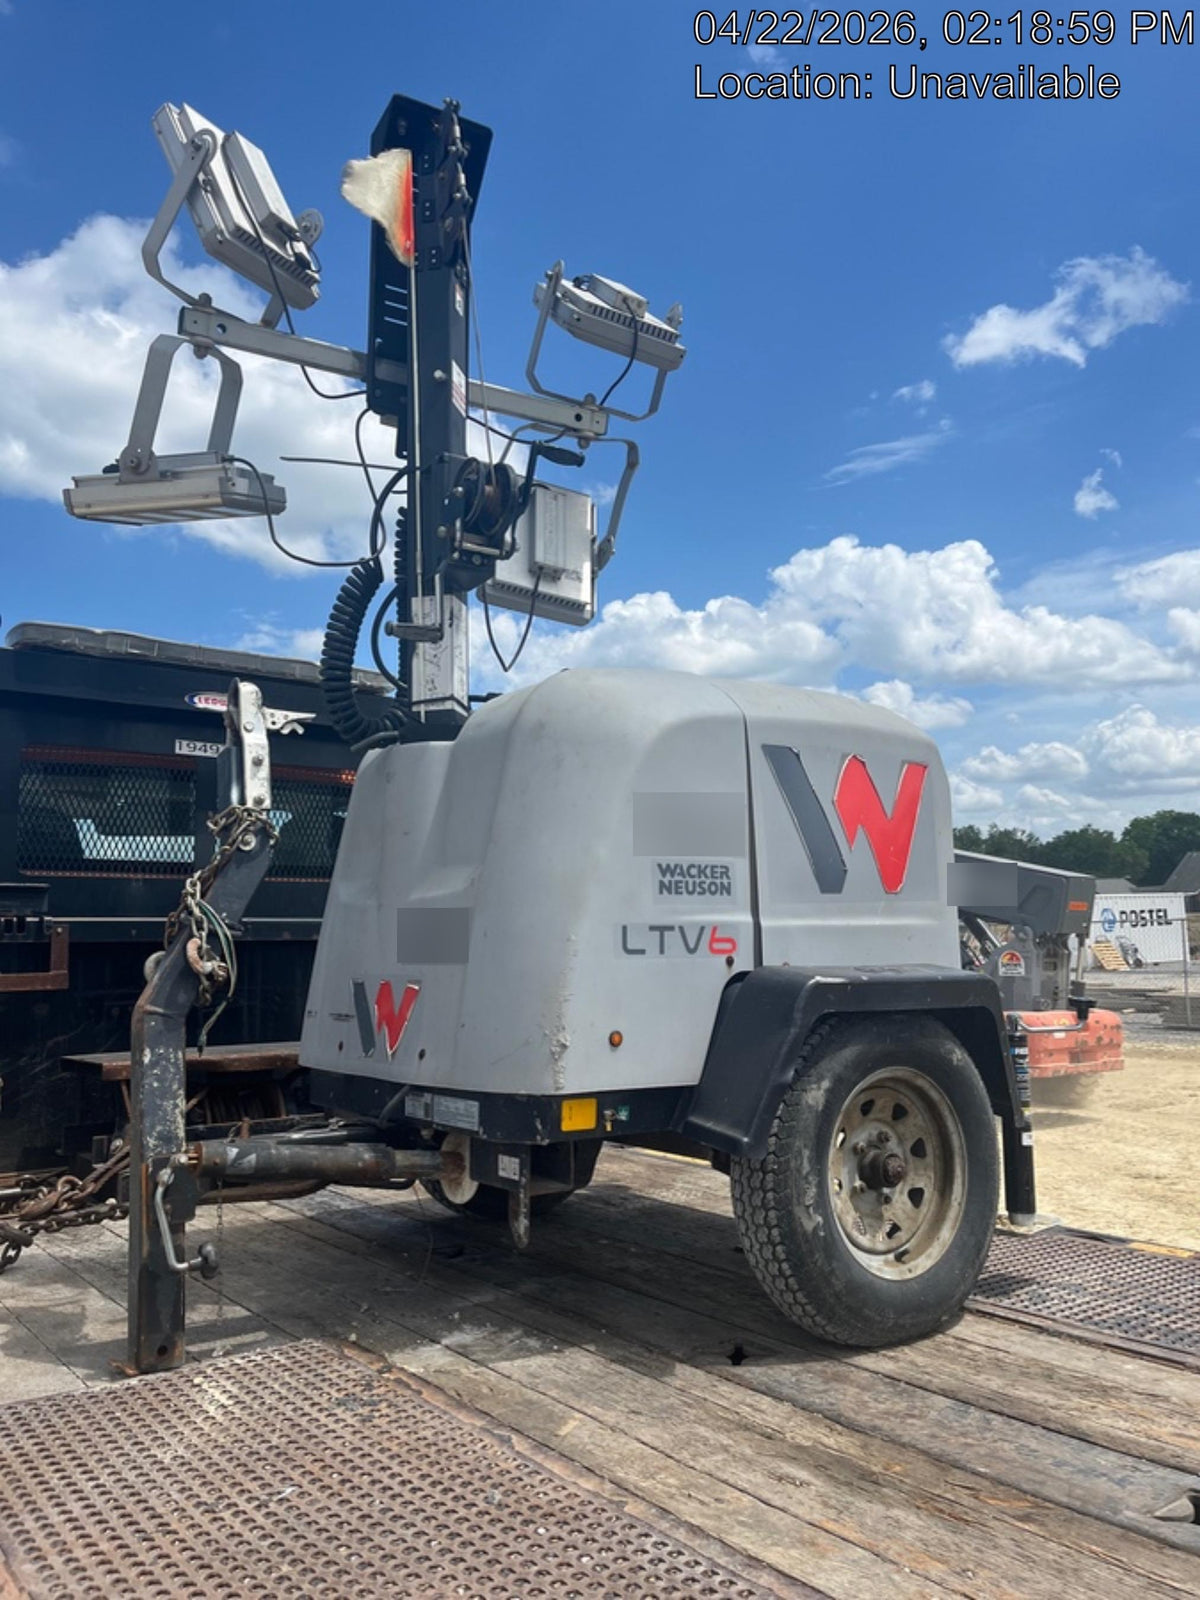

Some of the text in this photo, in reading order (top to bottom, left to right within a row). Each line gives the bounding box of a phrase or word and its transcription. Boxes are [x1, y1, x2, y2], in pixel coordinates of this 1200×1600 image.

[178, 741, 219, 754] 1949
[657, 863, 731, 880] WACKER
[659, 880, 731, 896] NEUSON
[1119, 908, 1173, 928] POSTEL
[621, 924, 737, 955] LTV6
